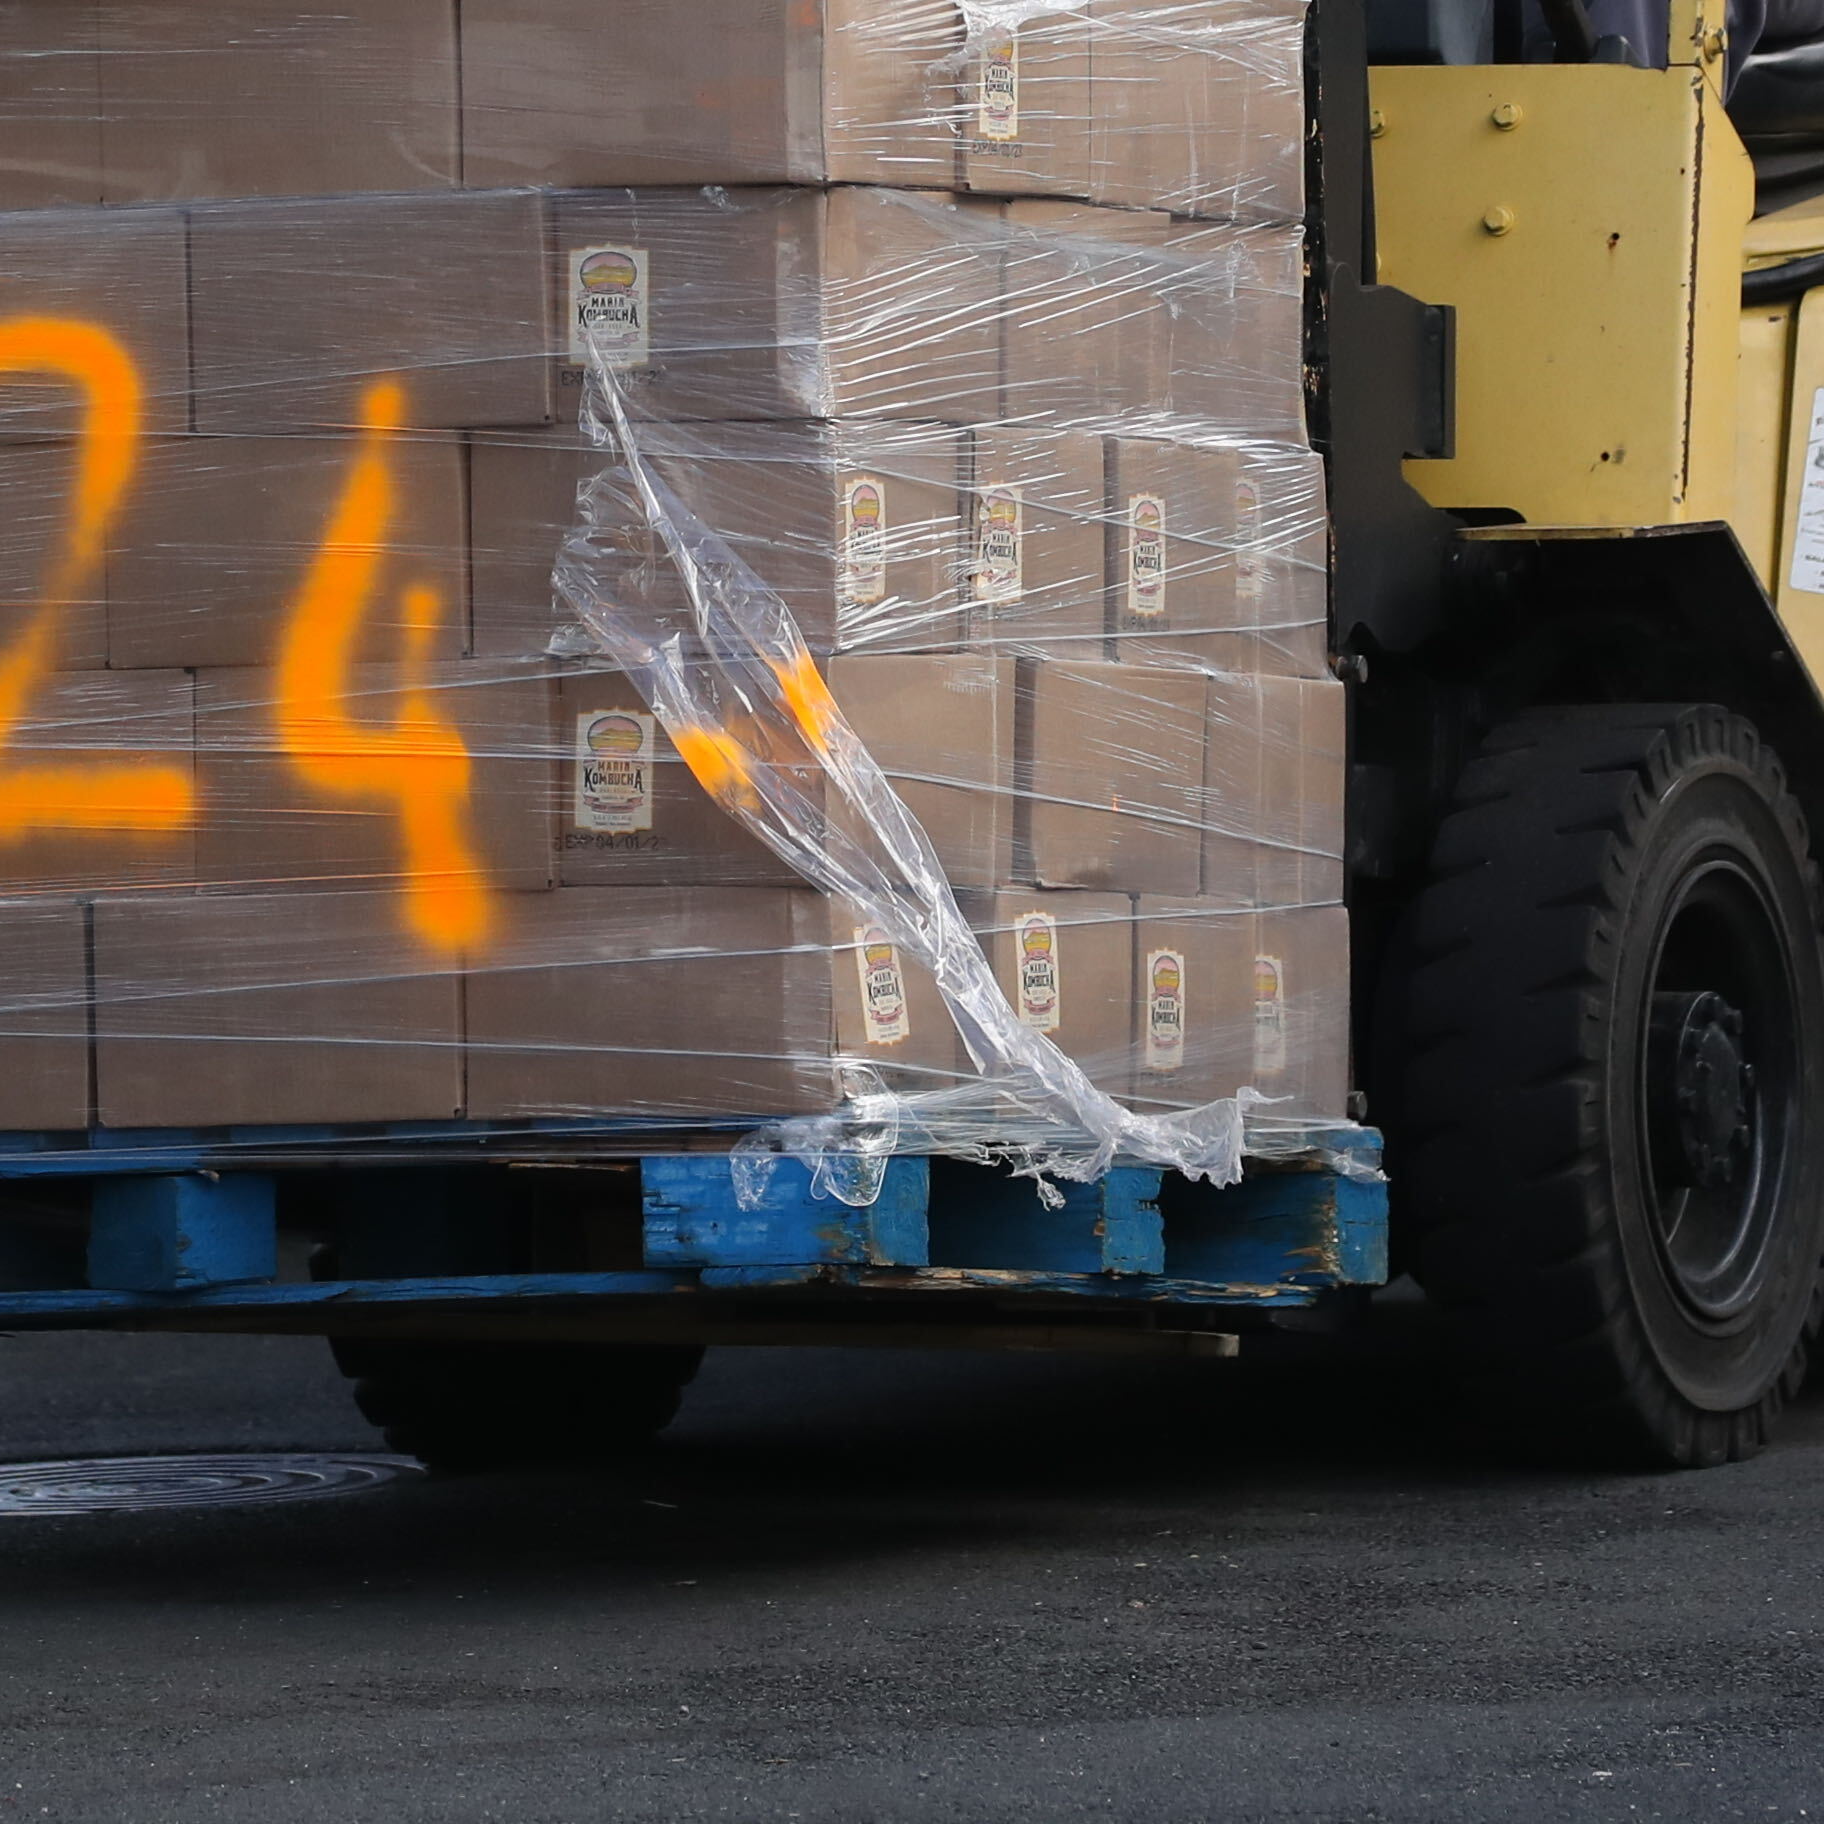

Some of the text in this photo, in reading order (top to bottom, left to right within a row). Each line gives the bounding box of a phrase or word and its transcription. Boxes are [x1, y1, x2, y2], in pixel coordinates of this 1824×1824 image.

[592, 297, 625, 307] MARIN
[578, 303, 640, 328] KOMBUCHA
[597, 761, 630, 773] MARIN
[584, 768, 645, 794] KOMBUCHA
